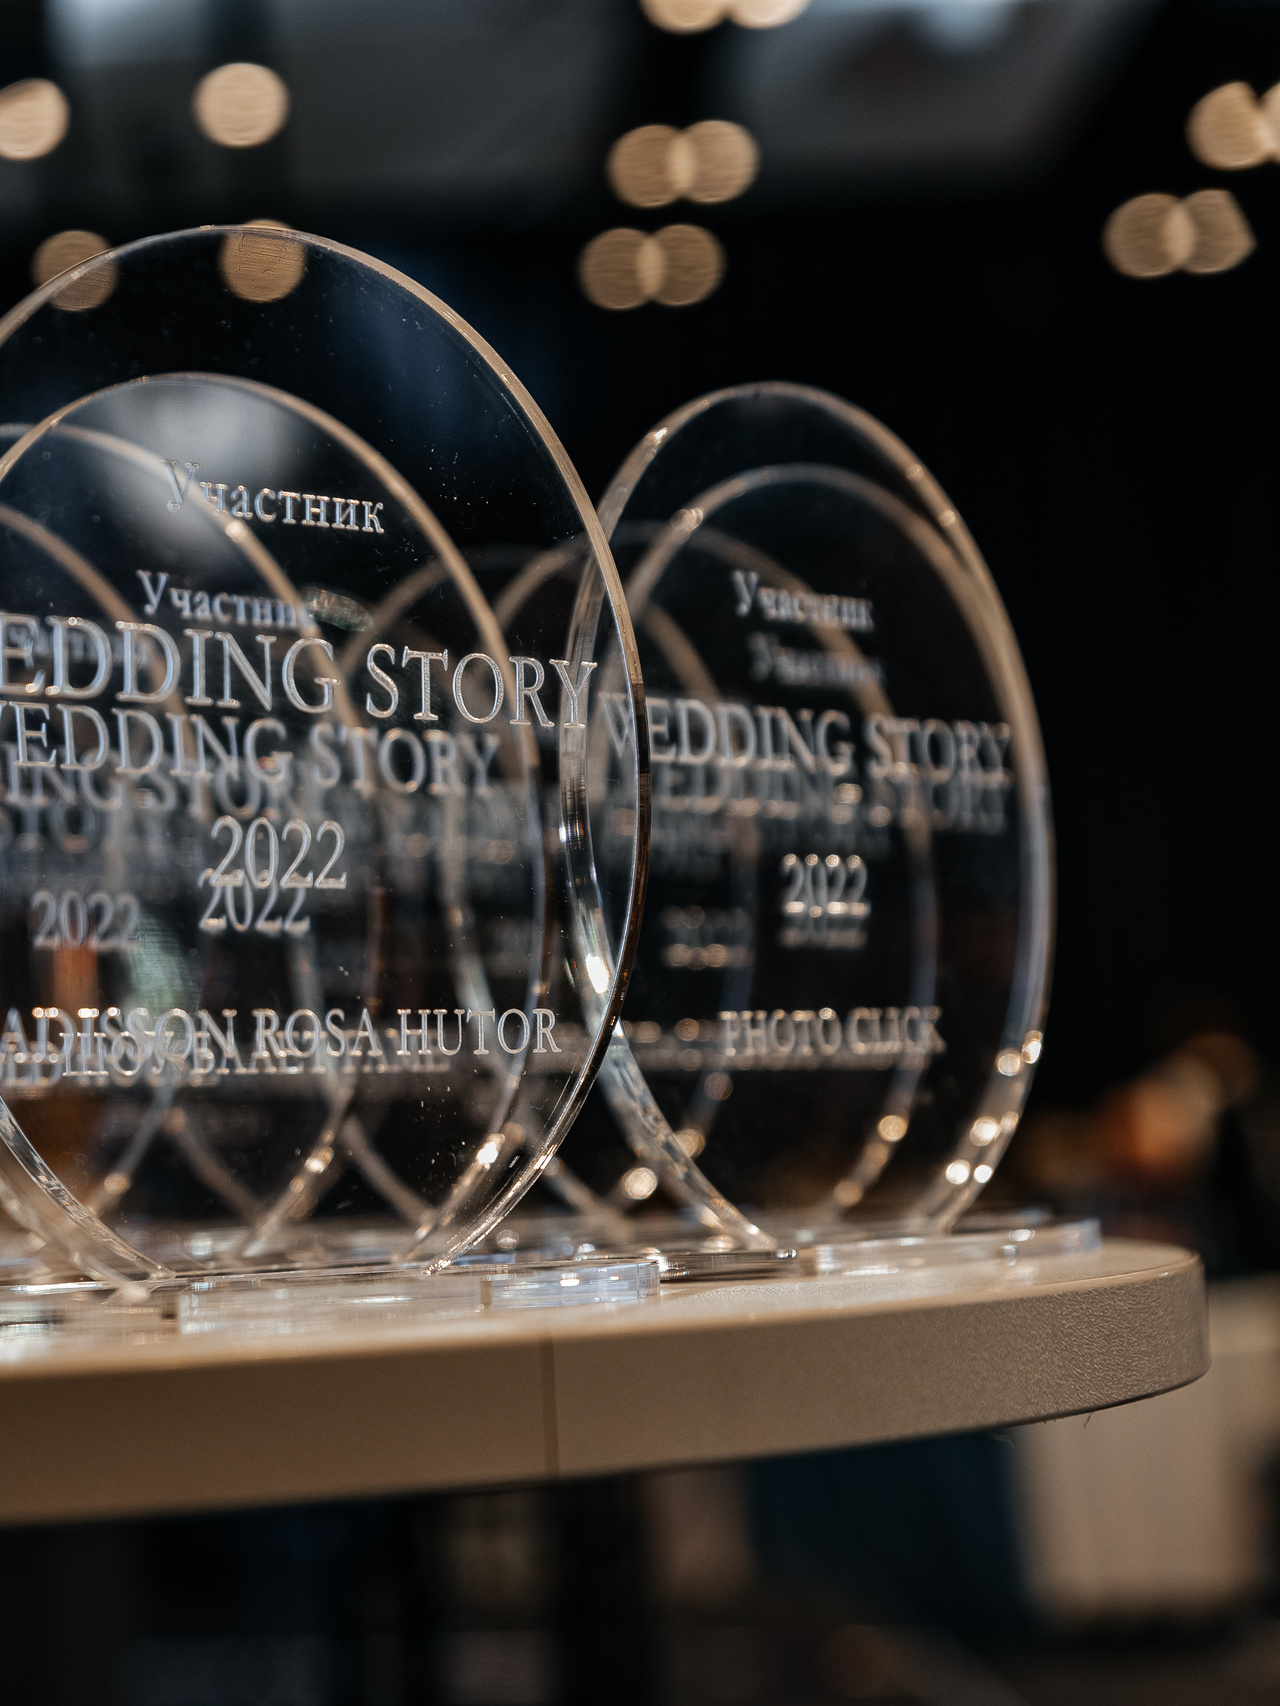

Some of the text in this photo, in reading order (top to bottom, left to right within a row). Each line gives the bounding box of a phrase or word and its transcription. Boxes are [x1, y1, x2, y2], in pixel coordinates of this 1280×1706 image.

[160, 458, 386, 534] Участник
[365, 642, 598, 730] STORY
[307, 718, 502, 798] STORY
[209, 815, 348, 889] 2022
[28, 888, 142, 950] 2022
[251, 1007, 383, 1060] ROSA
[396, 1007, 563, 1056] HUTOR
